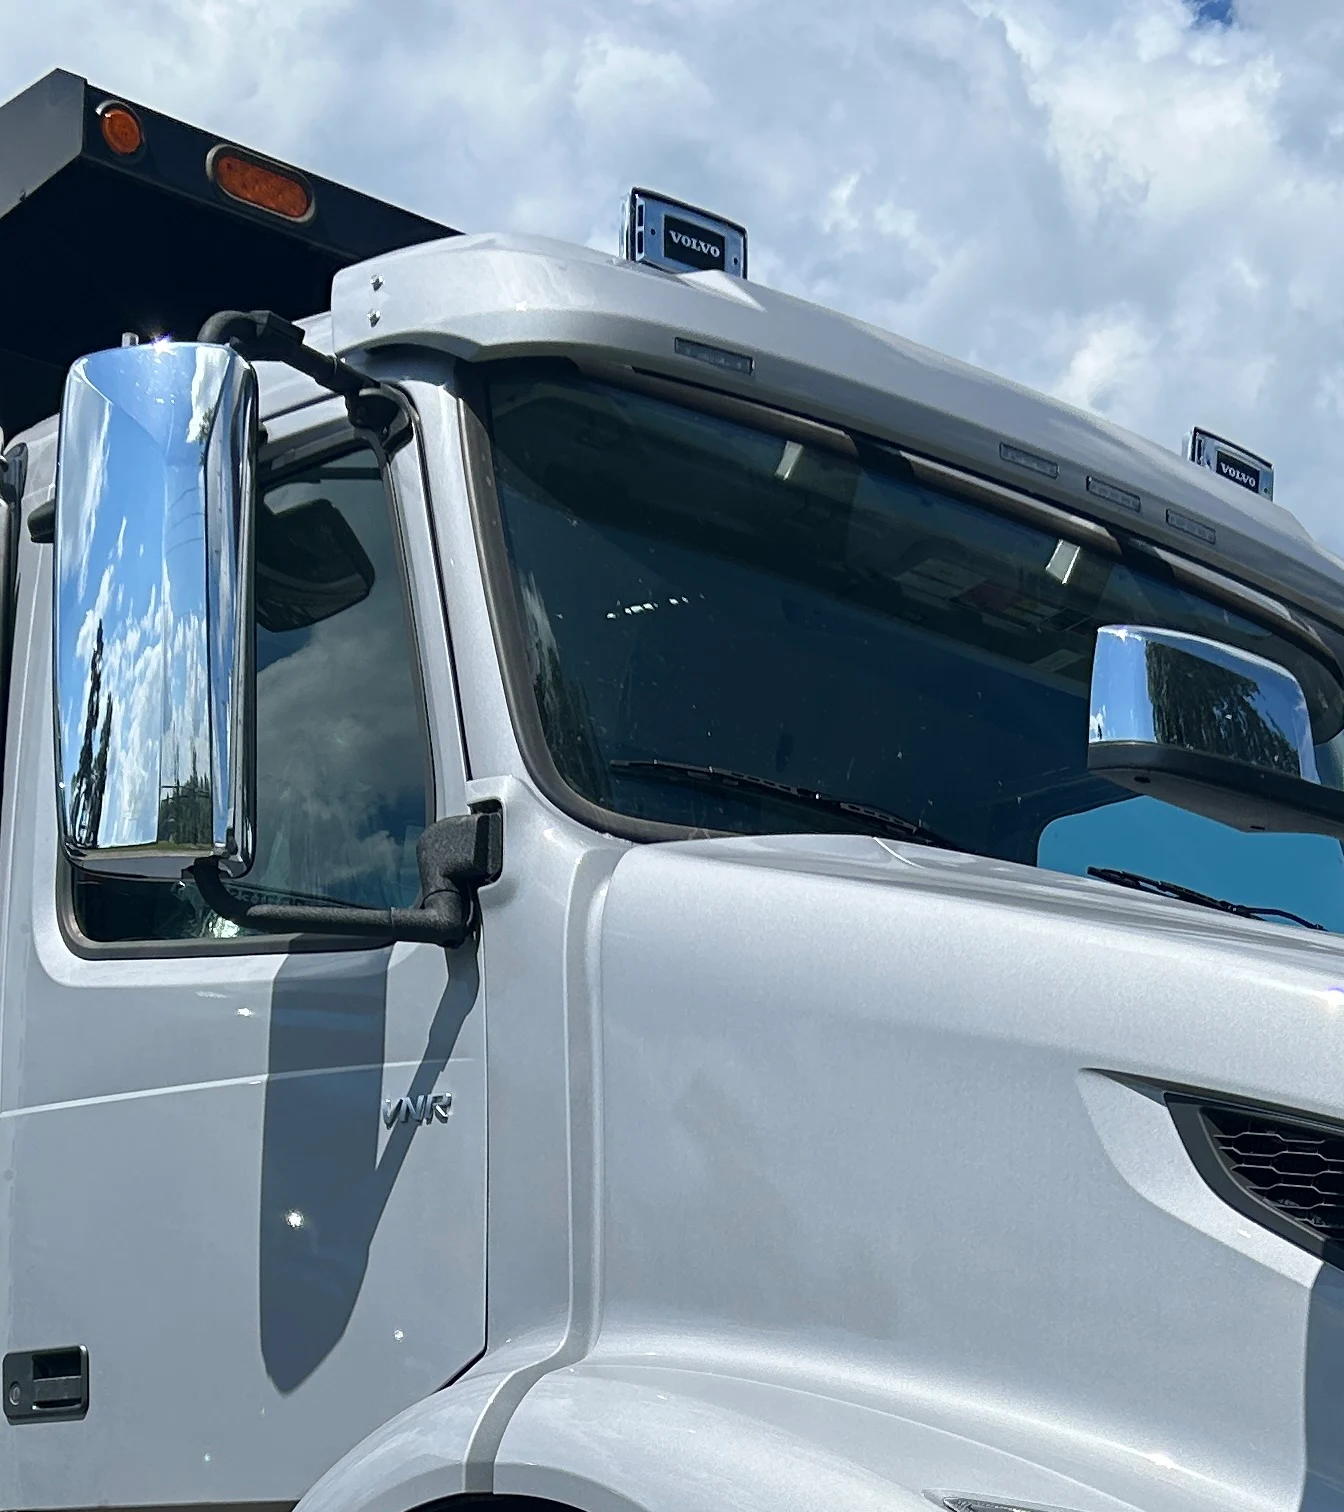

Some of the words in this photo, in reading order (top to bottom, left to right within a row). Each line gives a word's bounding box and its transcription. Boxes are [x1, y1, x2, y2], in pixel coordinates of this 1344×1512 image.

[669, 230, 721, 258] VOLVO
[1219, 461, 1257, 488] VOLVO
[381, 1092, 453, 1130] VNR
